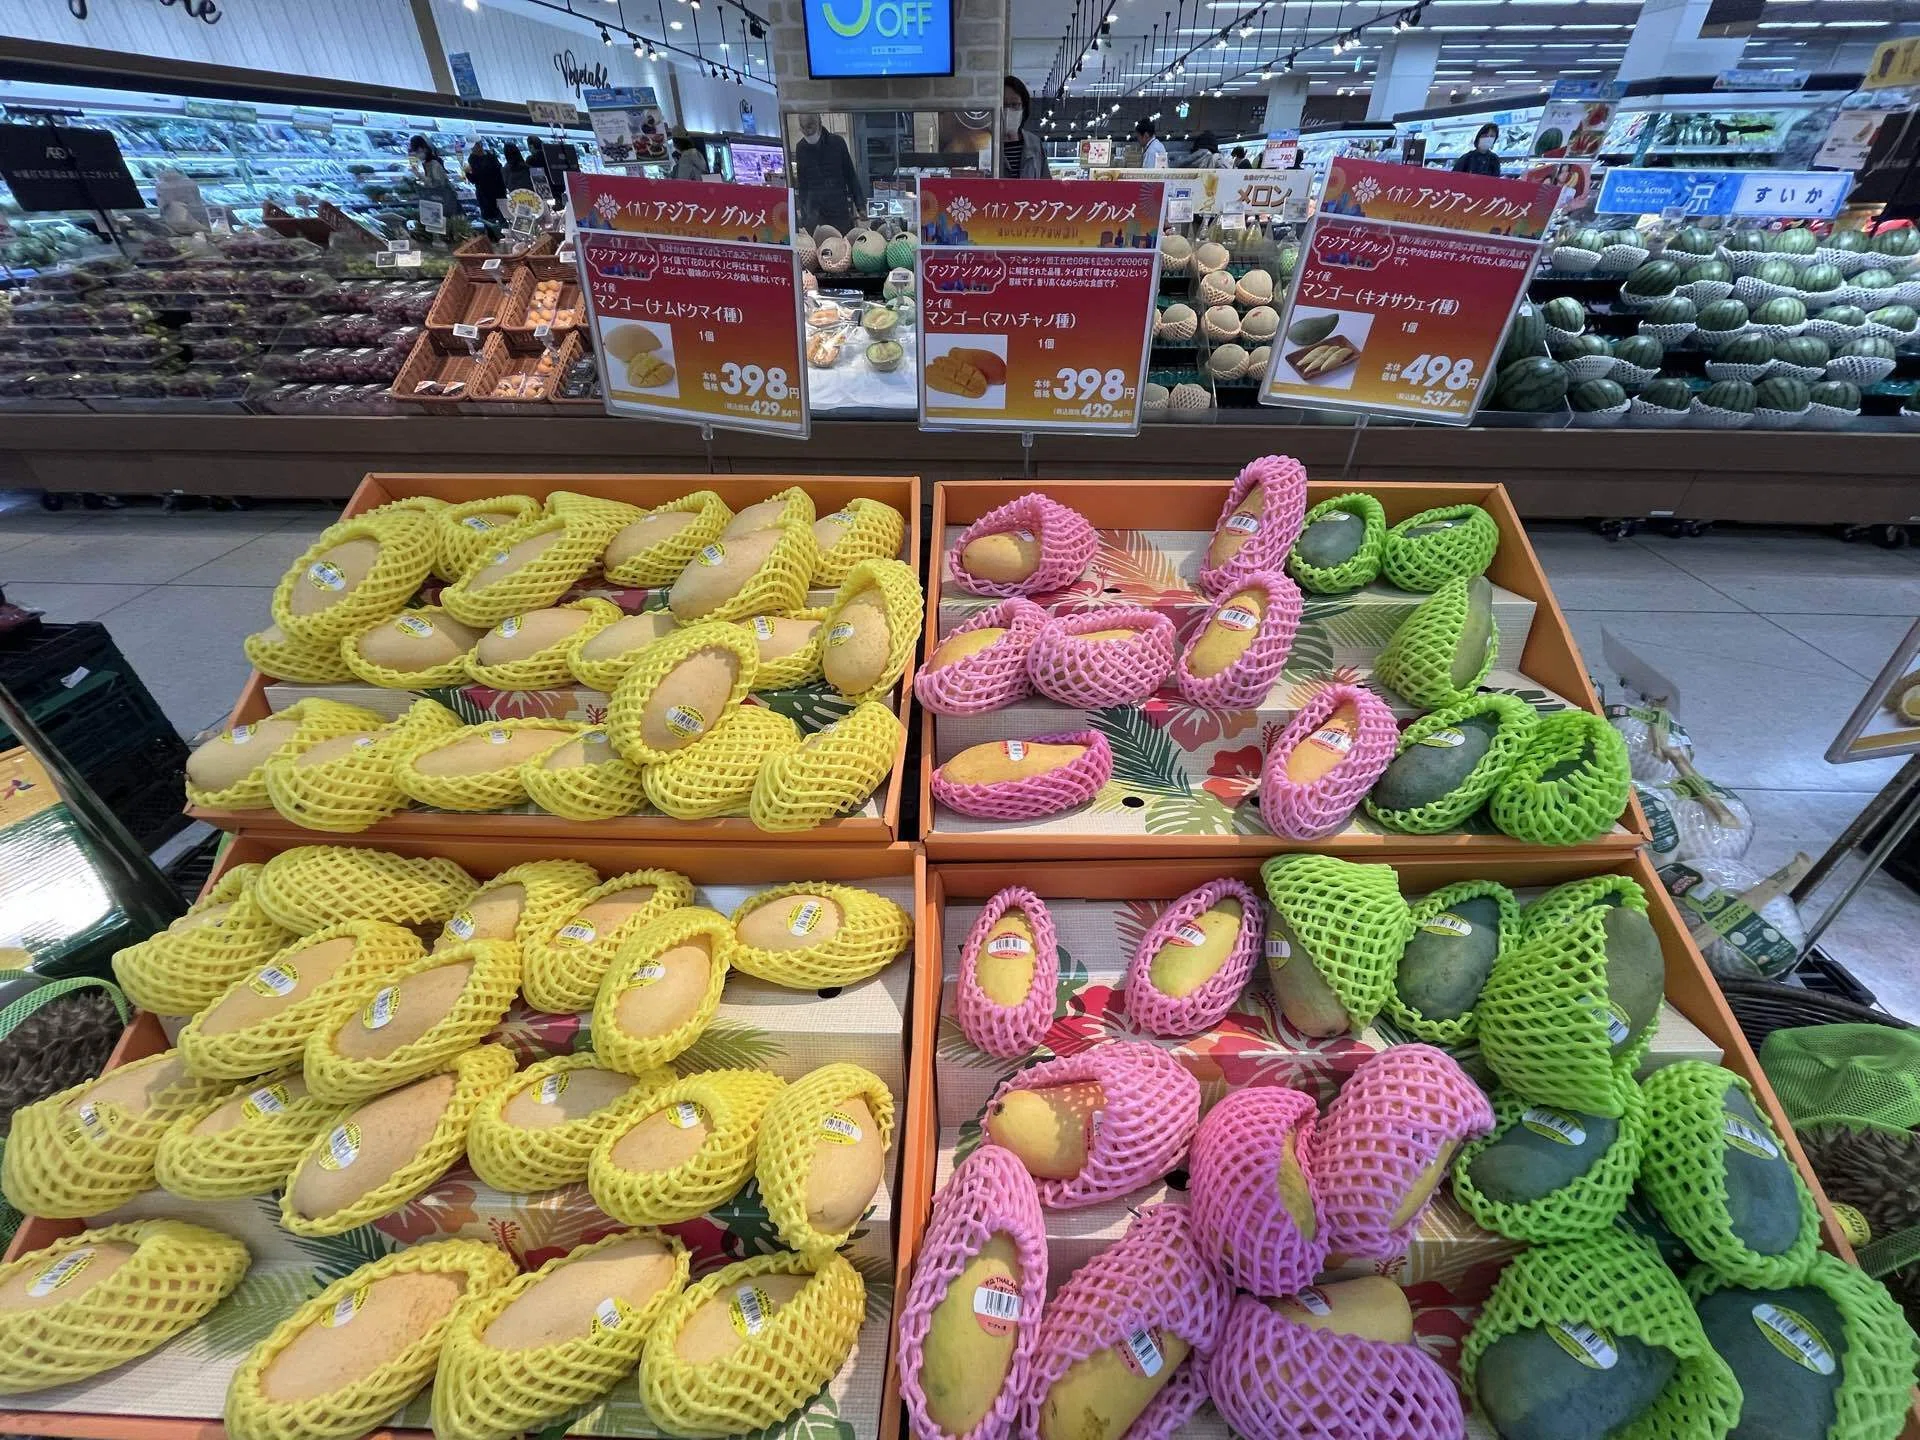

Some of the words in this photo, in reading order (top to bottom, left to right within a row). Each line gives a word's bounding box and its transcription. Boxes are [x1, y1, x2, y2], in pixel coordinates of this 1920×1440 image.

[876, 1, 932, 37] OFF
[1238, 184, 1292, 208] メロン
[1386, 185, 1412, 203] イオン
[1756, 187, 1823, 204] すいか
[625, 201, 650, 217] イオン
[982, 202, 1009, 220] イオン
[1316, 235, 1391, 254] アジアングルメ
[589, 248, 656, 265] アジアングルメ
[928, 265, 1003, 279] アジアングルメ
[1305, 270, 1332, 282] タイ産
[592, 282, 616, 294] タイ産
[925, 299, 952, 309] タイ産
[1302, 282, 1460, 316] マンゴー(キオサウェイ種)
[595, 294, 743, 324] マンゴー(ナムドクマイ種)
[925, 311, 1077, 329] マンゴー(マハチャノ種)
[1401, 322, 1418, 334] 1個
[699, 330, 715, 343] 1個
[1038, 338, 1055, 350] 1個
[1034, 380, 1050, 389] 本体
